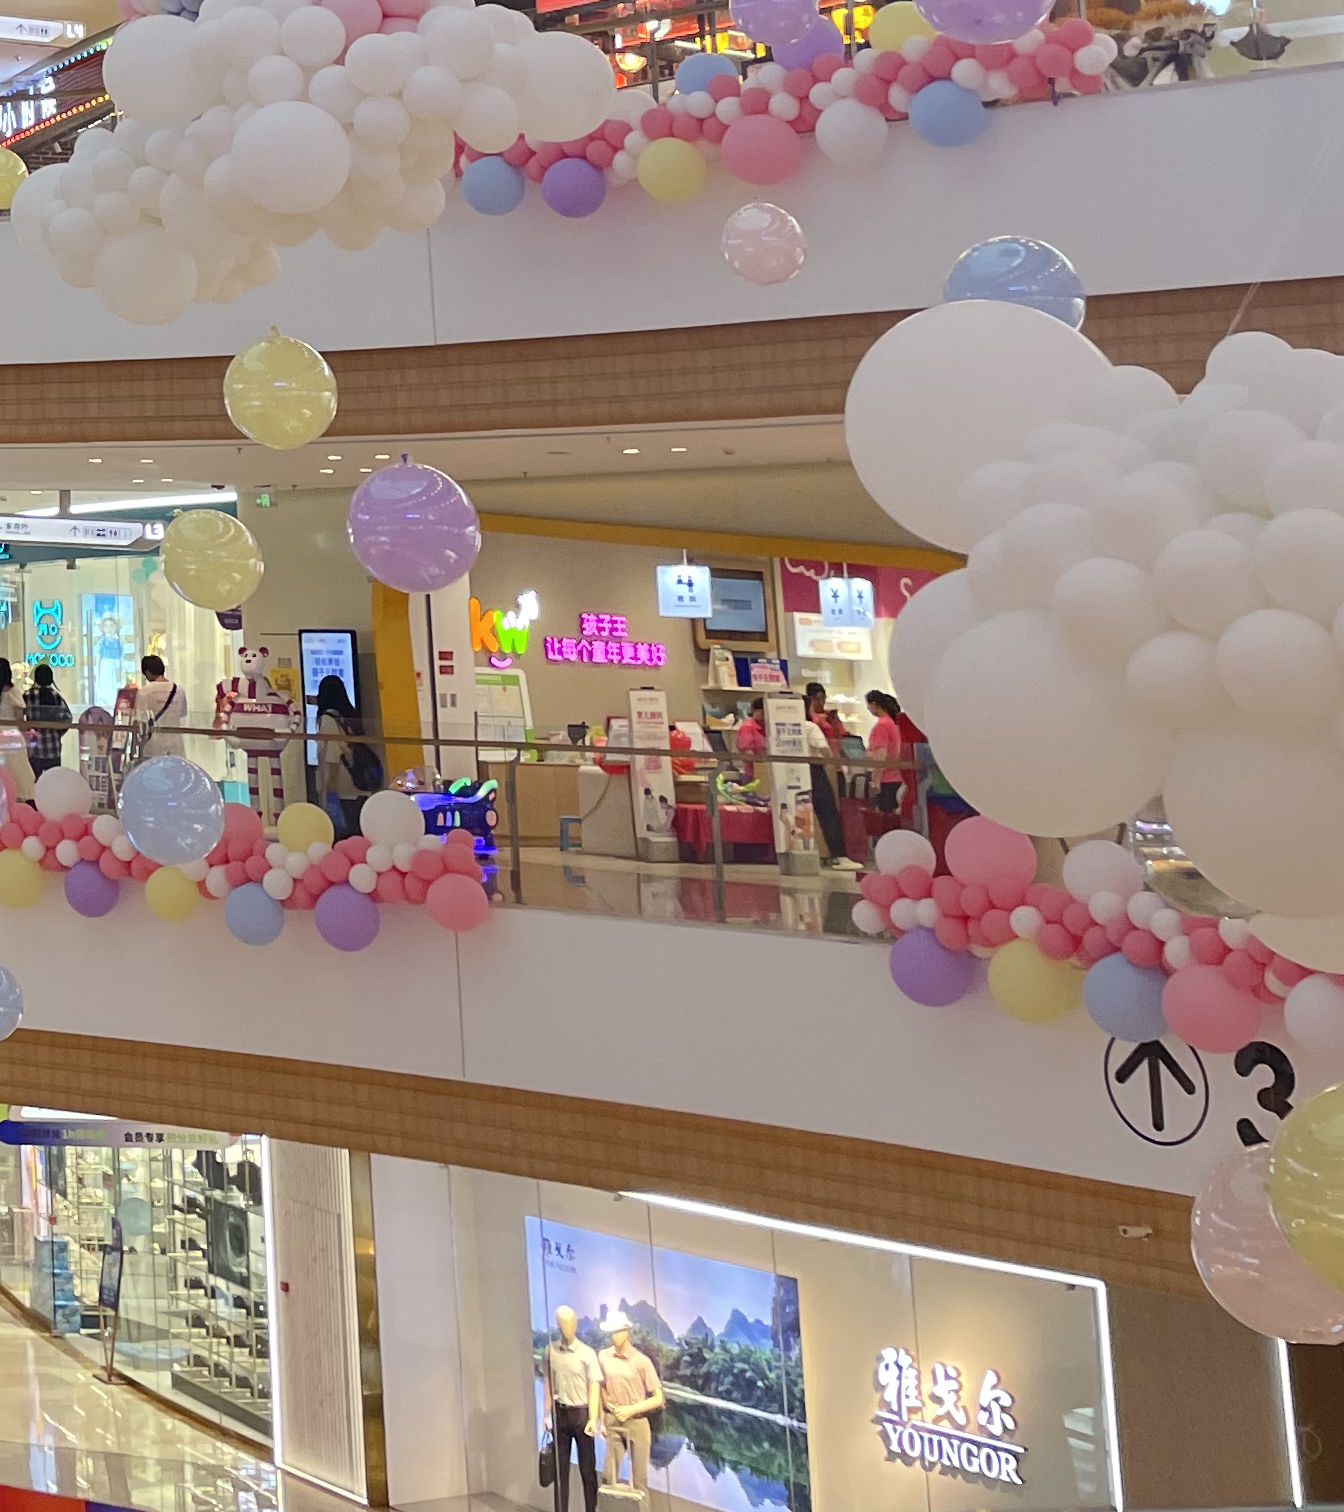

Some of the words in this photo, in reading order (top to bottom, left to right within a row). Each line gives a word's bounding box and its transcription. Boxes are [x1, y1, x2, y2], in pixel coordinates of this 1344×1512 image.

[579, 612, 629, 638] 孩子王
[544, 636, 667, 667] 让每个童年更美好
[243, 702, 273, 713] WHAT
[876, 1345, 1016, 1437] 雅戈尔
[882, 1424, 1025, 1486] YOUNGOR
